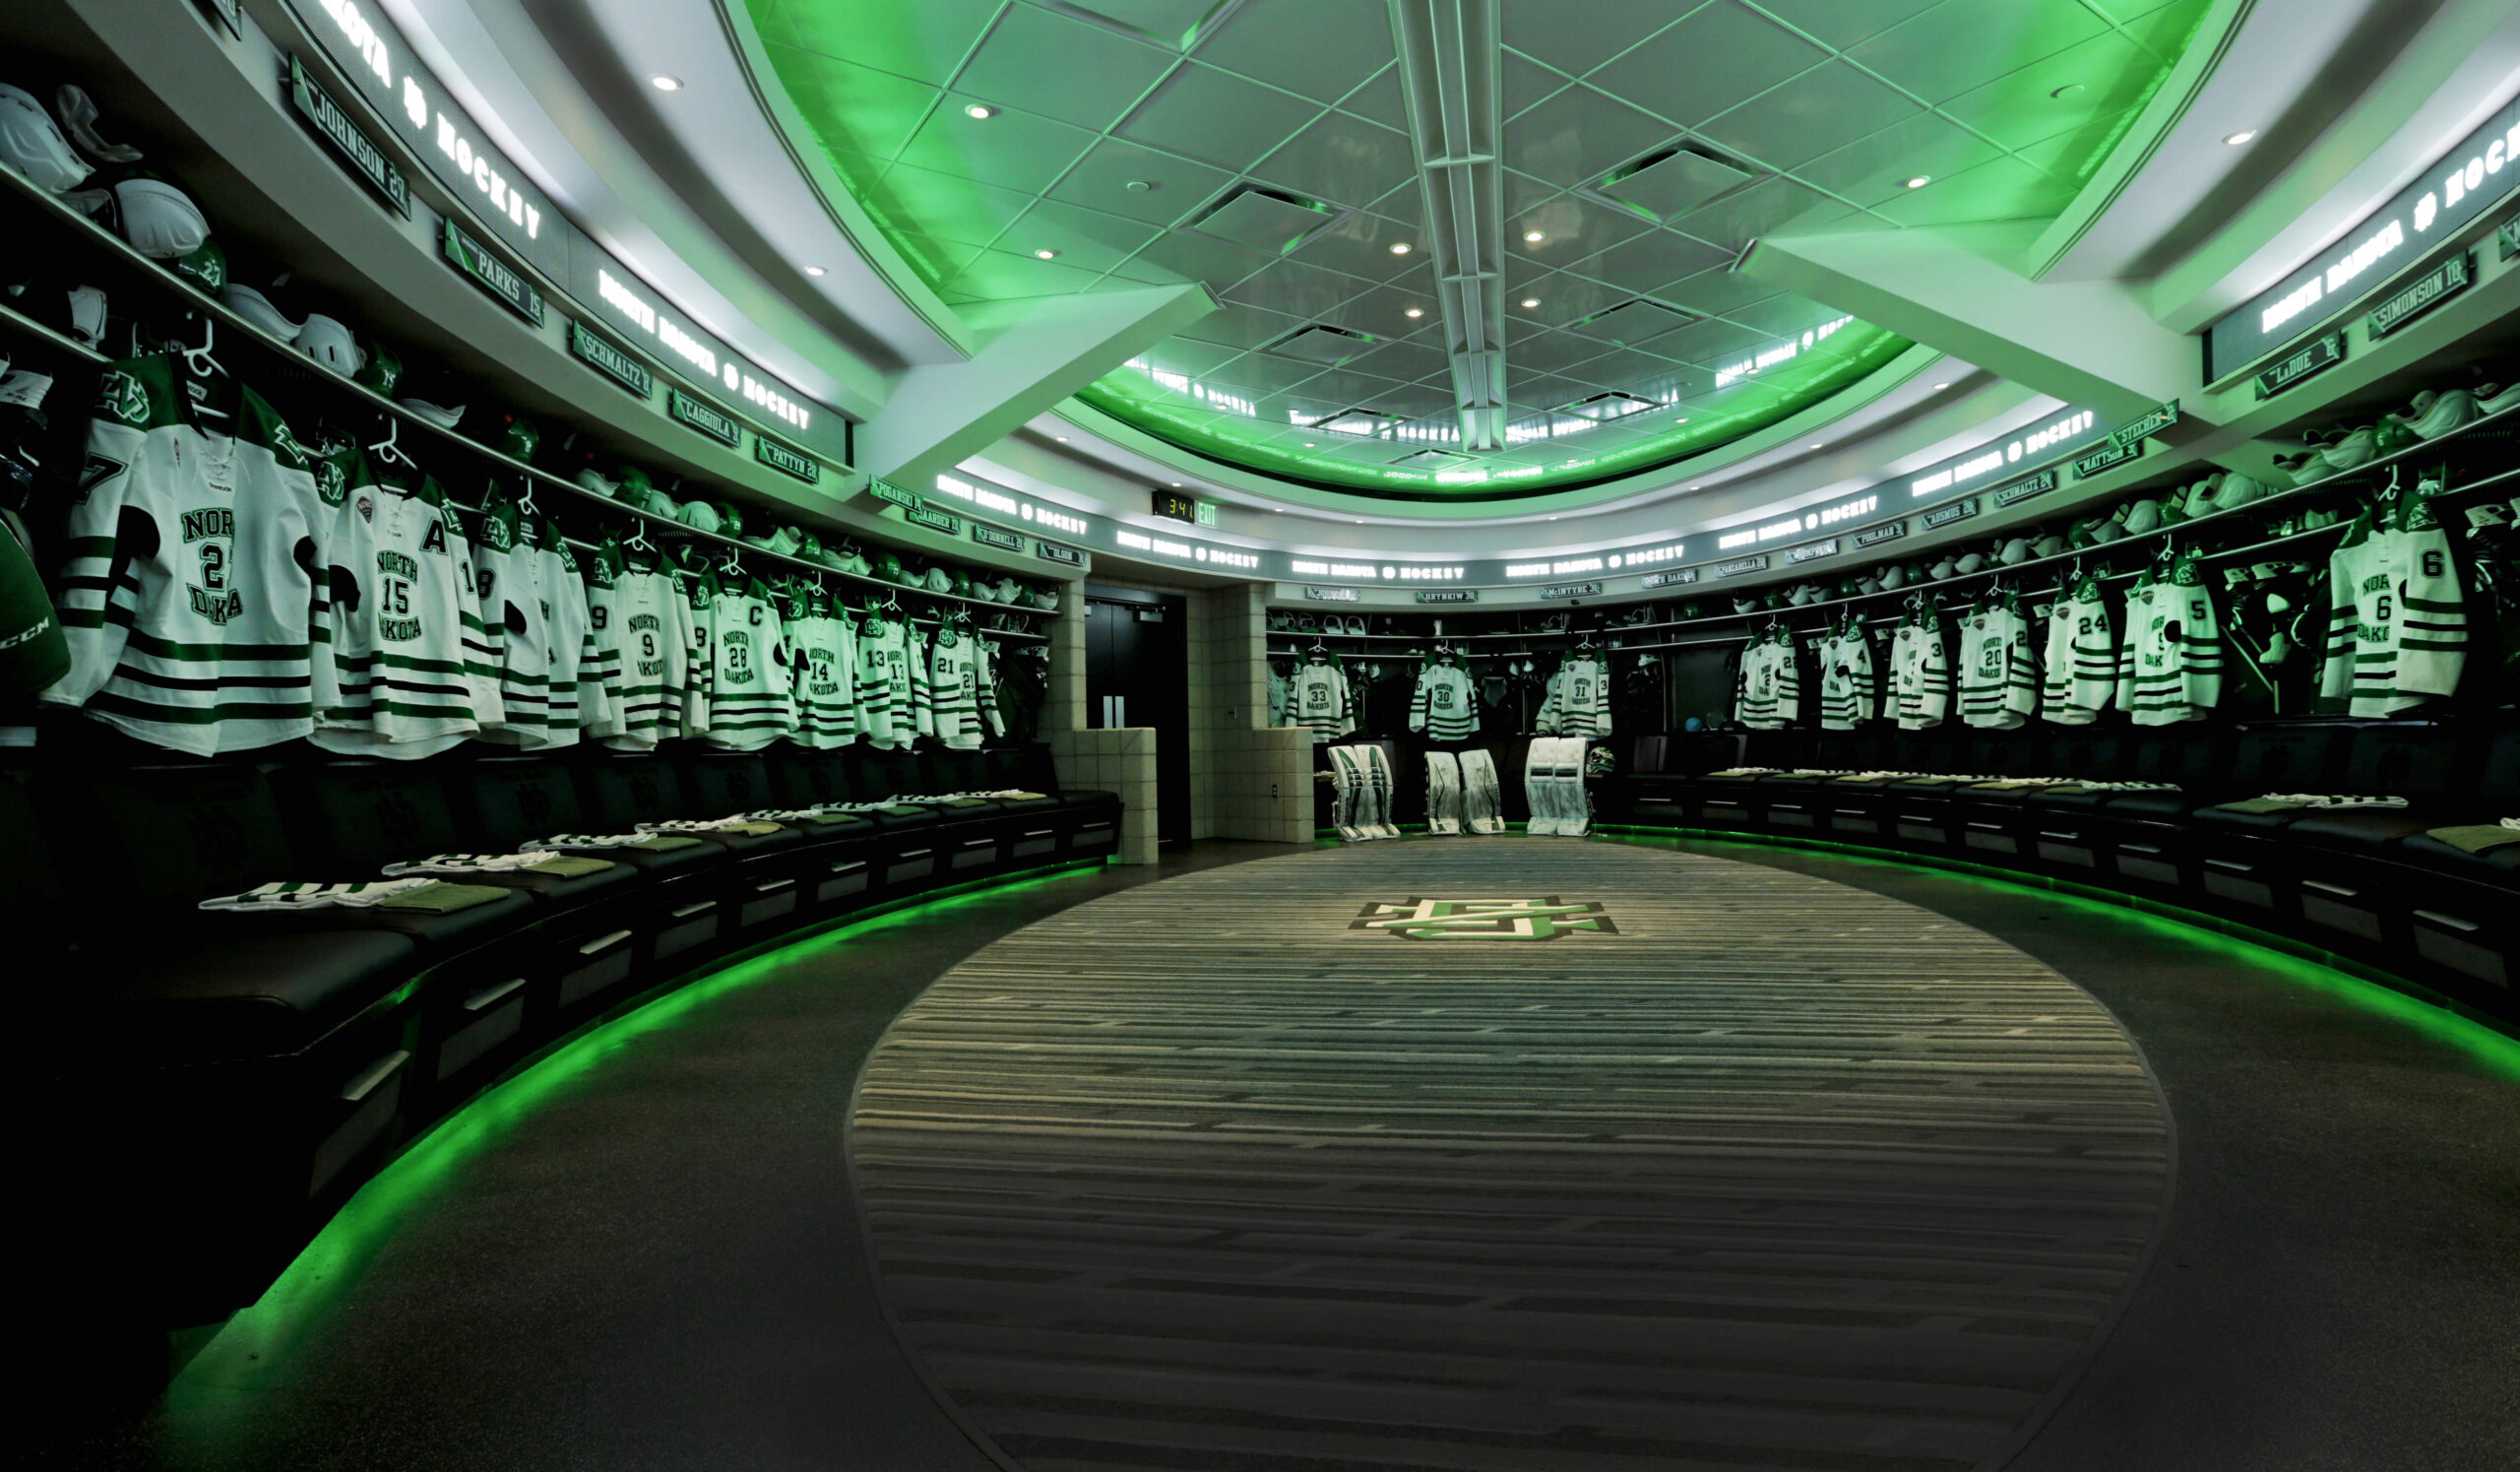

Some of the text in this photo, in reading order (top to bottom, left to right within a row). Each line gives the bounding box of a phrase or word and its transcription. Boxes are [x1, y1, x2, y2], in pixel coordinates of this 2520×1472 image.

[316, 96, 405, 204] JOHNSON 27
[438, 112, 539, 238] HOCKEY
[478, 251, 540, 317] PARKS 15
[2379, 260, 2461, 326] SIMONSON 10
[586, 335, 650, 391] SCHMALTZ 8
[743, 375, 809, 429] HOCKEY
[687, 402, 729, 437] CAGGIULA
[2026, 411, 2093, 454] HOCKEY
[2120, 412, 2163, 442] STECHER
[773, 448, 804, 474] PATTYN
[1037, 508, 1087, 535] HOCKEY
[1198, 502, 1217, 526] EXIT
[1821, 495, 1877, 525] HOCKEY
[181, 508, 235, 544] NOR
[419, 516, 449, 555] A
[200, 543, 232, 592] 2
[377, 549, 417, 585] NORTH
[1053, 547, 1074, 562] OLSON
[1210, 549, 1258, 568] HOCKEY
[1626, 544, 1683, 565] HOCKEY
[2421, 548, 2445, 579] 6
[476, 567, 497, 602] 8
[1400, 567, 1464, 579] HOCKEY
[2363, 573, 2391, 596] NOR
[382, 576, 410, 617] 15
[2376, 595, 2392, 621] 6
[591, 605, 608, 631] 9
[749, 605, 764, 626] C
[2190, 600, 2207, 620] 5
[0, 616, 49, 650] CCM
[378, 612, 422, 642] KOTA
[2078, 614, 2108, 636] 24
[642, 633, 656, 657] 9
[729, 647, 747, 669] 28
[1858, 651, 1866, 664] 4
[1930, 642, 1941, 658] 3
[811, 662, 829, 680] 14
[866, 651, 886, 668] 13
[937, 658, 953, 674] 21
[963, 673, 976, 689] 21
[1575, 686, 1586, 697] 31
[1601, 680, 1607, 690] 3
[1311, 691, 1326, 702] 33
[1437, 691, 1450, 702] 30
